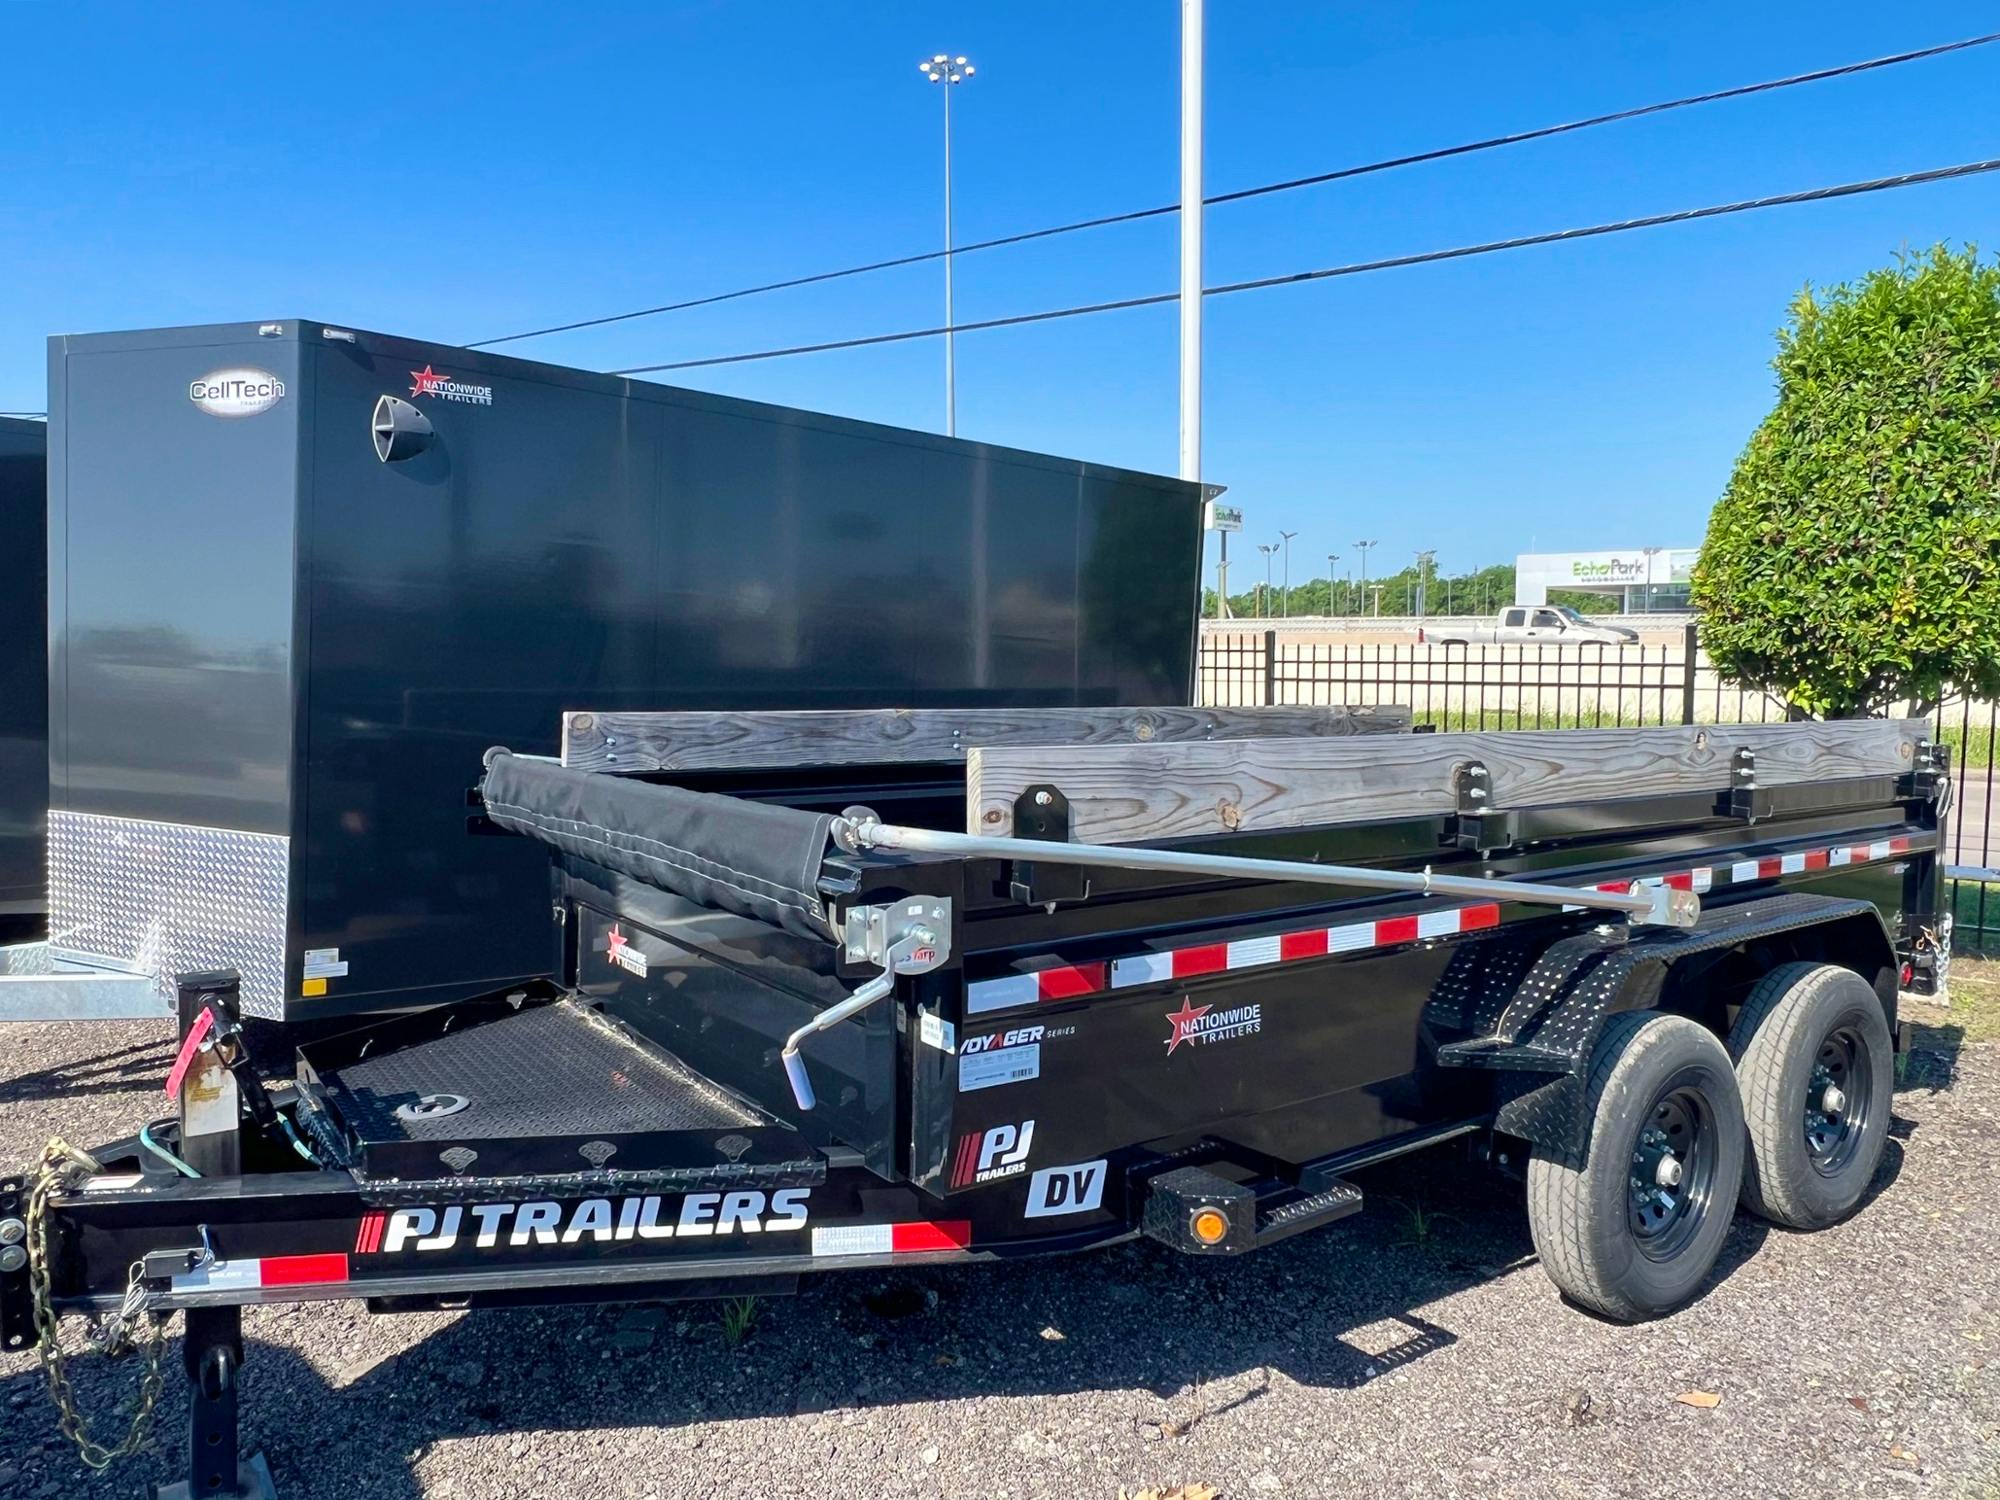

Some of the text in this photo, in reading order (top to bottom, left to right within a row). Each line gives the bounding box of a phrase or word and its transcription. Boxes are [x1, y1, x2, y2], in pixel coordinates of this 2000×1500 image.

[190, 378, 284, 400] CellTech
[423, 379, 492, 397] NATIONWIDE
[441, 392, 492, 405] TRAILERS
[1572, 558, 1645, 577] EchoPark
[1180, 1004, 1261, 1035] NATIONWIDE
[1046, 1026, 1076, 1039] SERIES
[1201, 1022, 1261, 1045] TRAILERS
[977, 1119, 1035, 1171] PJ
[975, 1161, 1026, 1183] TRAILERS
[1044, 1167, 1096, 1208] DV
[383, 1188, 811, 1253] PJ TRAILERS
